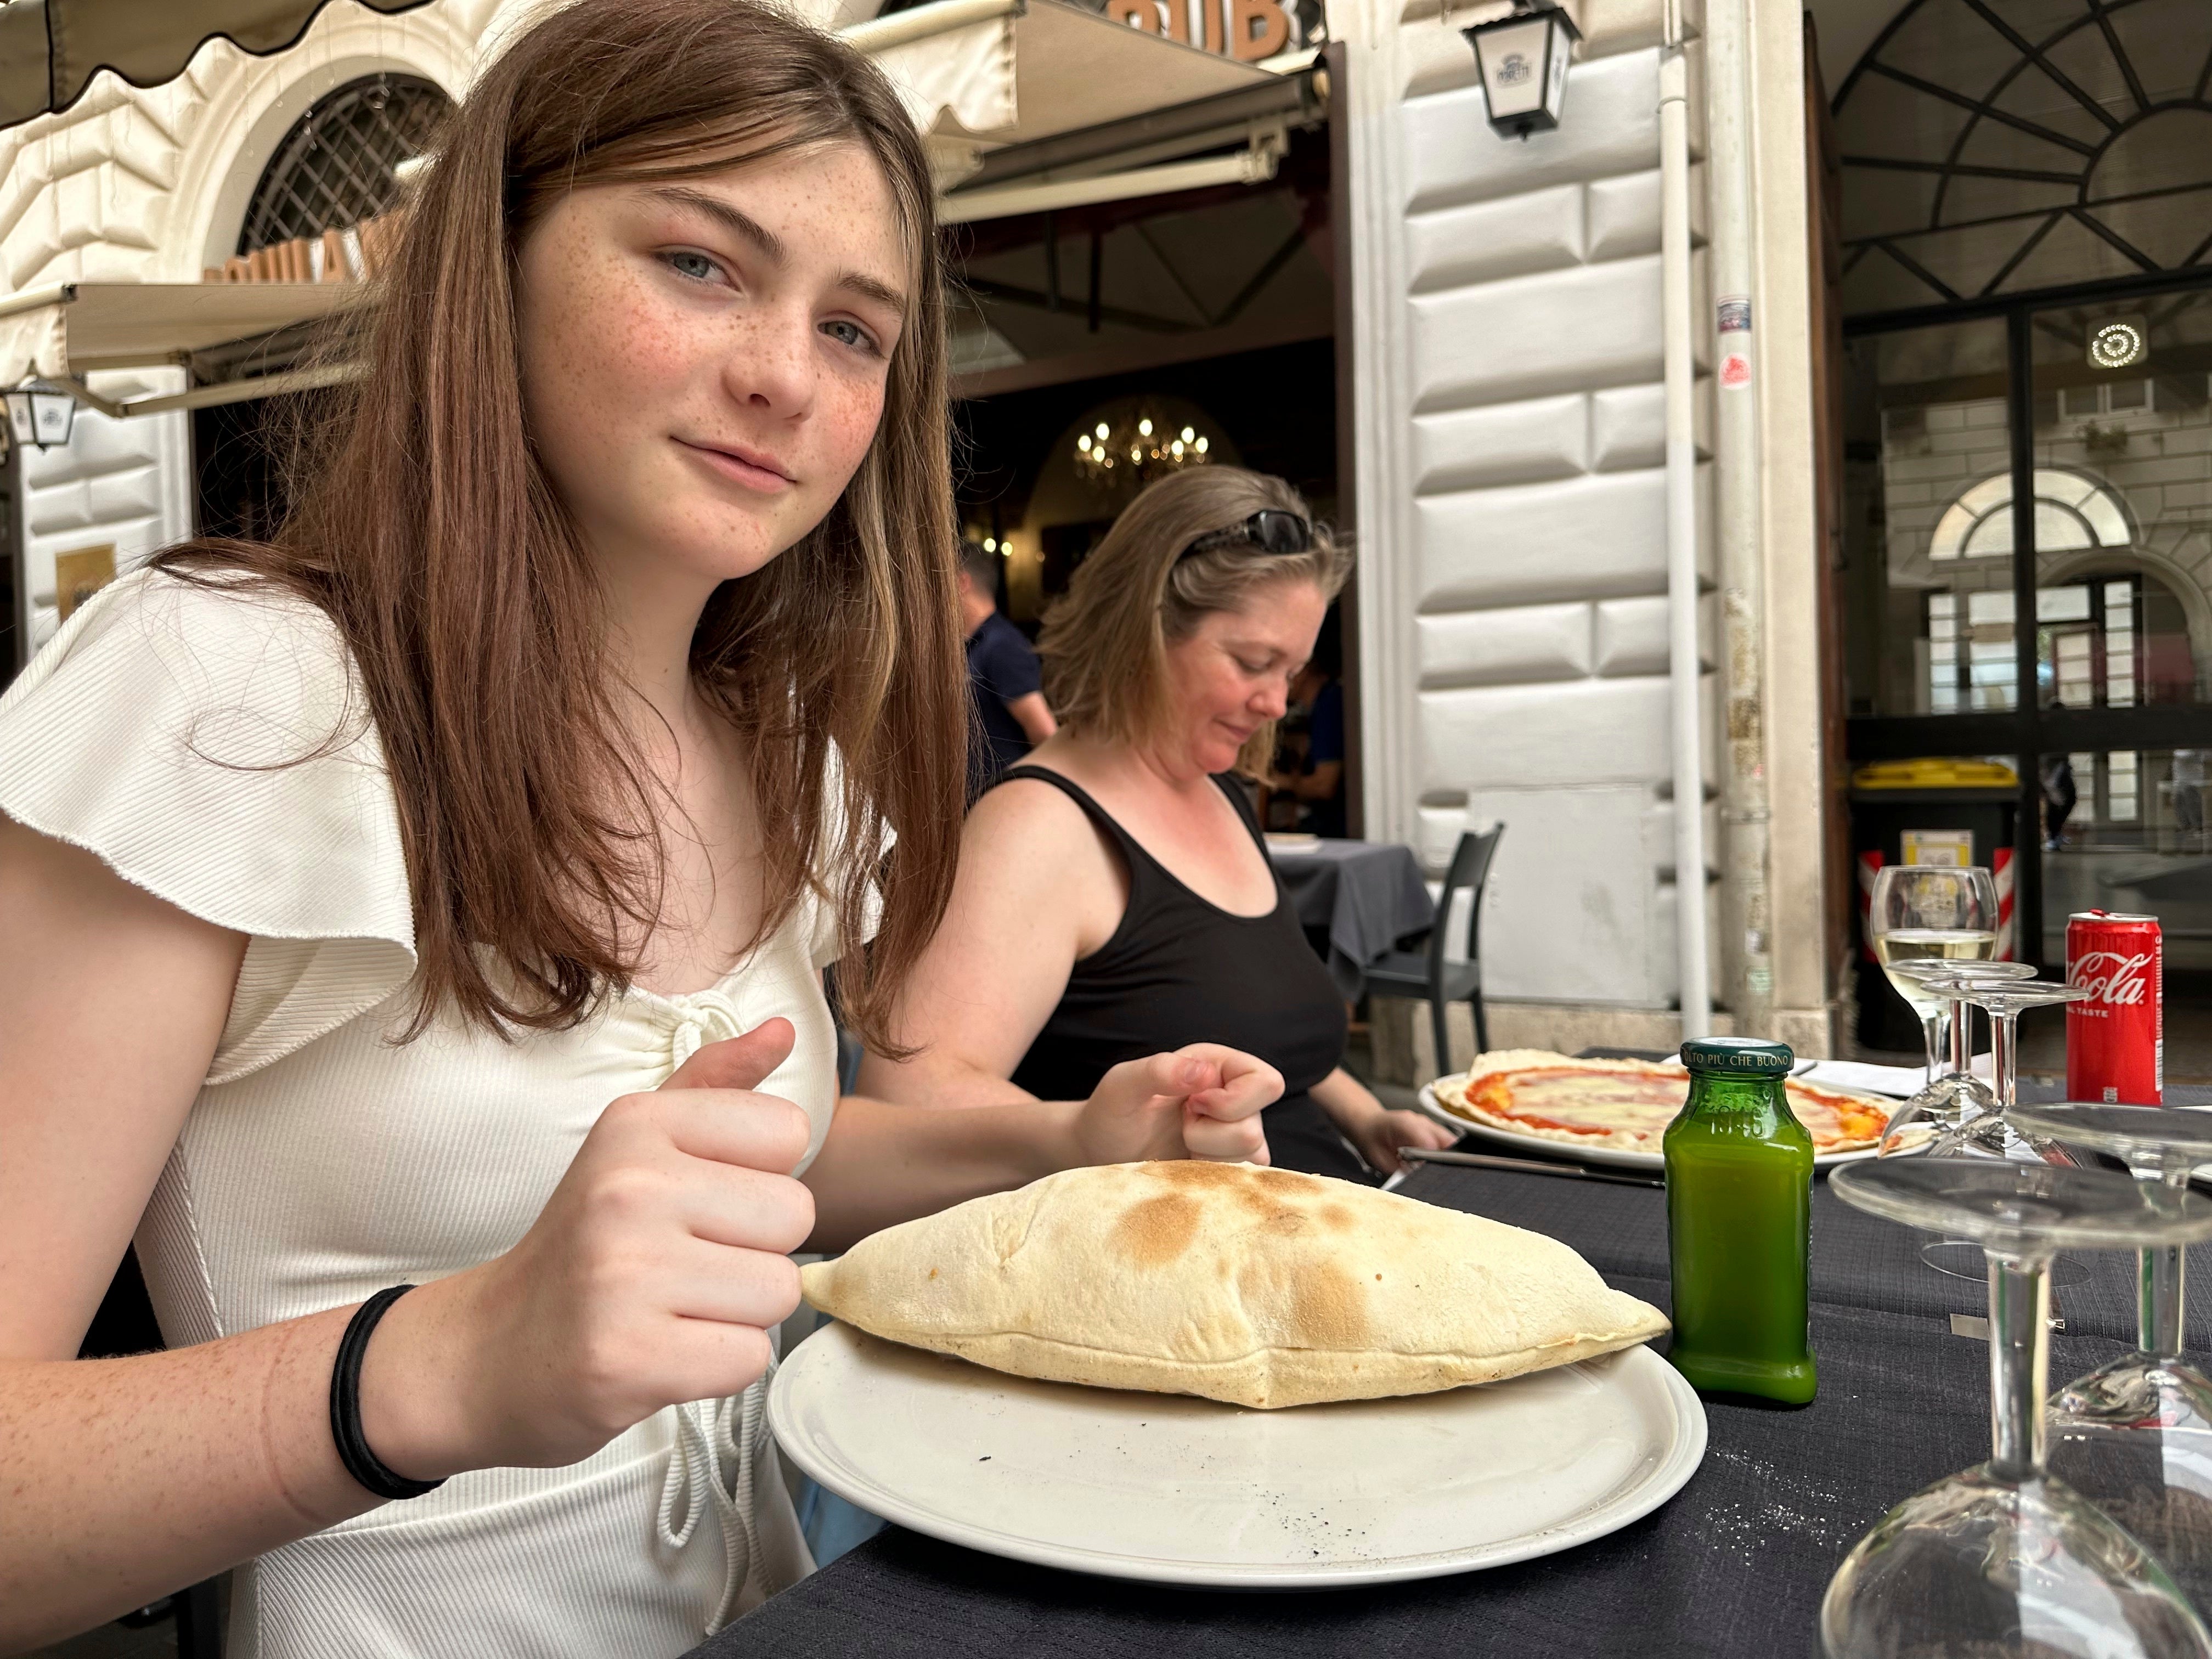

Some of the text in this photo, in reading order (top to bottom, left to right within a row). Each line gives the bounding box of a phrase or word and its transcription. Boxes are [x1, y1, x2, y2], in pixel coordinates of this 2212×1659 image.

[2078, 1007, 2109, 1018] TASTE
[1708, 1052, 1725, 1065] PIÙ
[1730, 1055, 1752, 1066] CHE
[1757, 1054, 1788, 1066] BUONO
